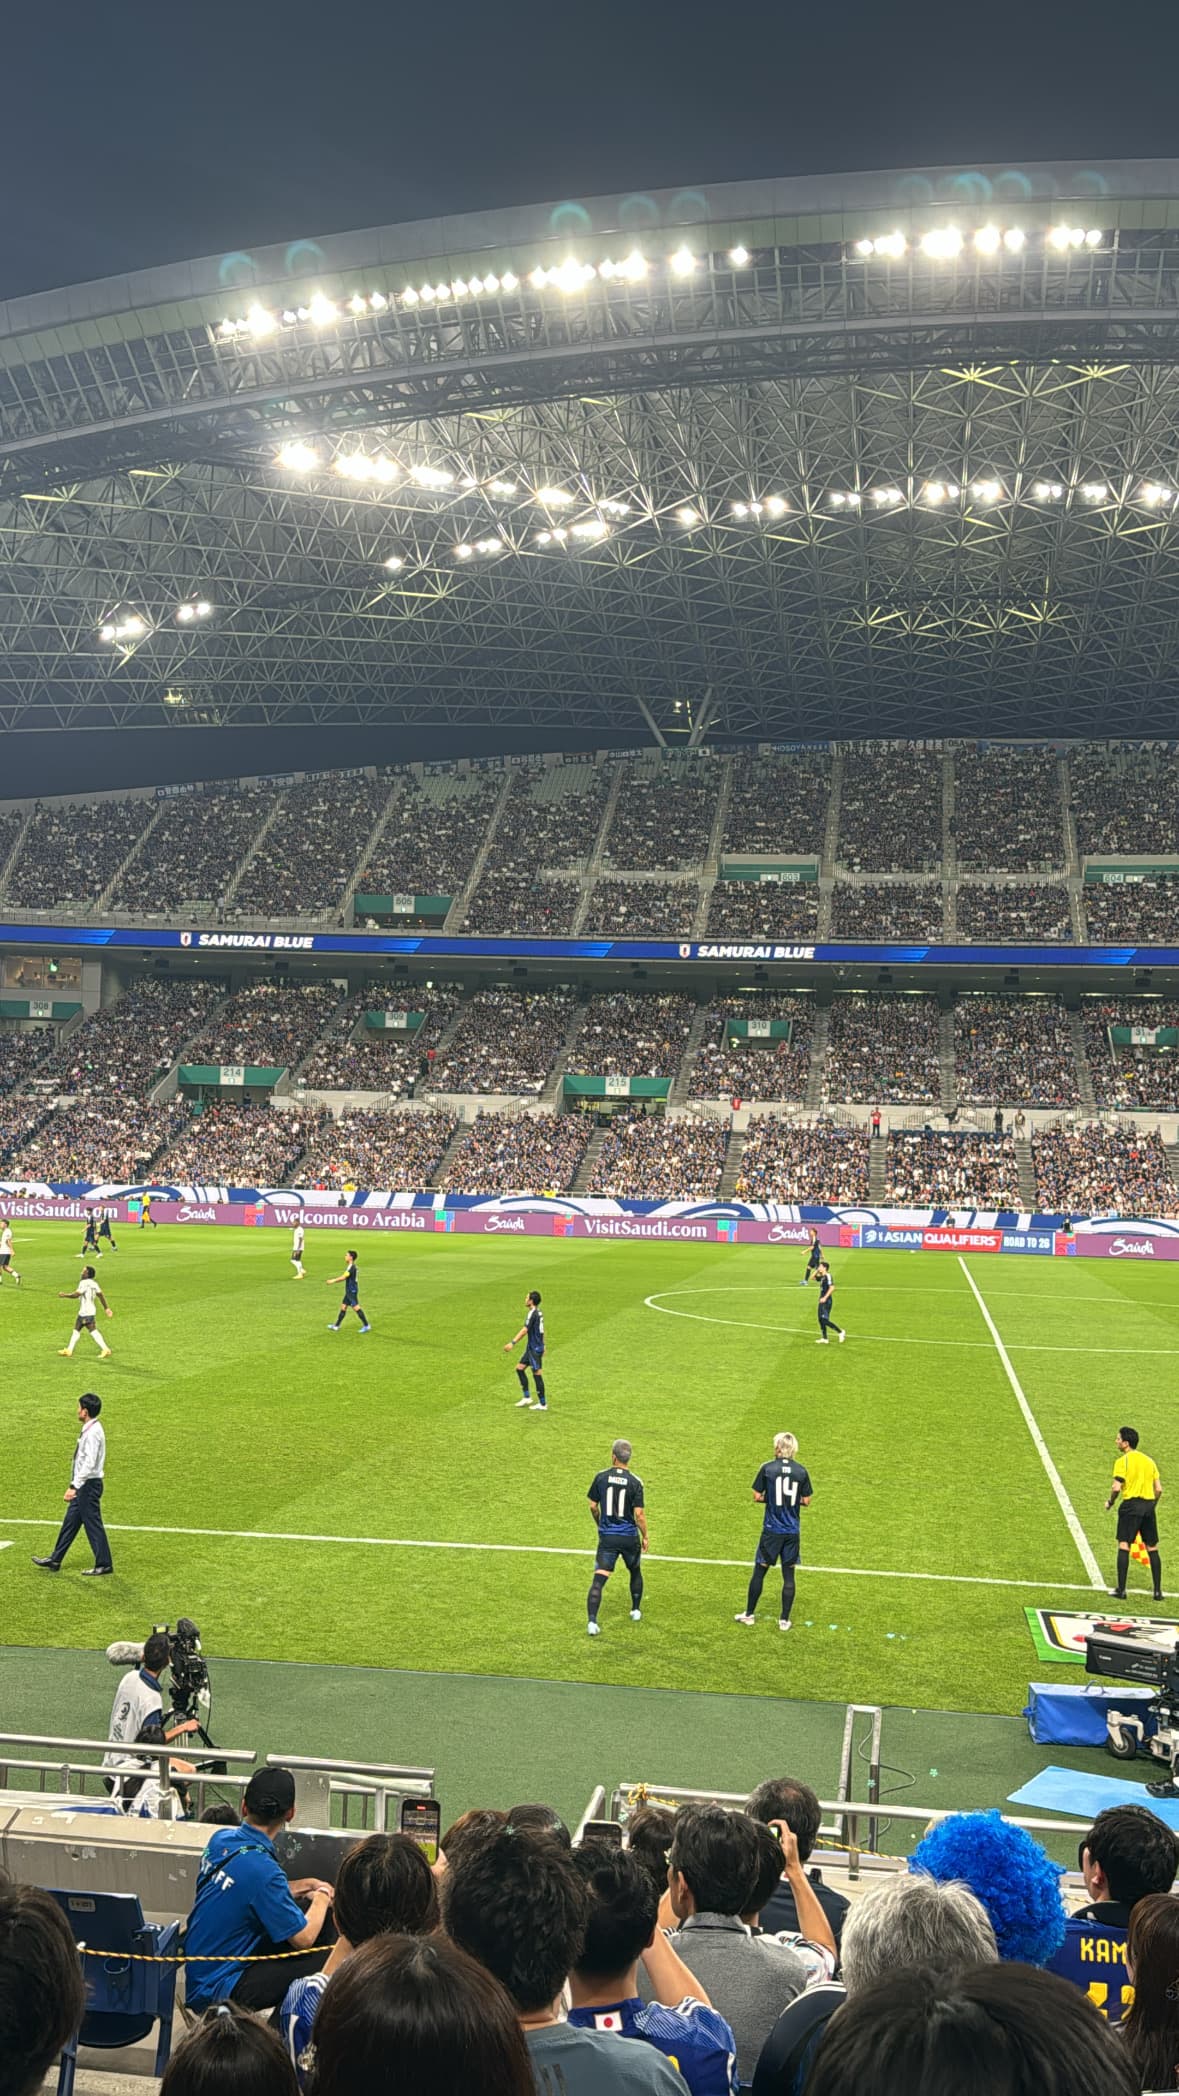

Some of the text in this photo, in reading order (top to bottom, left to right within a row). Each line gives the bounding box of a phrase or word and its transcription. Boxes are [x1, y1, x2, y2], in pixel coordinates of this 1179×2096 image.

[782, 873, 799, 881] 603
[198, 934, 314, 949] SAMURAI BLUE
[697, 945, 816, 959] SAMURAI BLUE
[751, 1021, 767, 1029] 310
[223, 1067, 241, 1077] 214
[608, 1077, 627, 1087] 215
[274, 1208, 425, 1228] Welcome to Arabia
[584, 1218, 708, 1238] VisitSaudi.com
[884, 1231, 923, 1243] ASIAN
[924, 1233, 997, 1246] QUALIFIERS
[1003, 1235, 1050, 1249] ROAD TO 26
[775, 1476, 799, 1506] 14
[606, 1486, 626, 1517] 11
